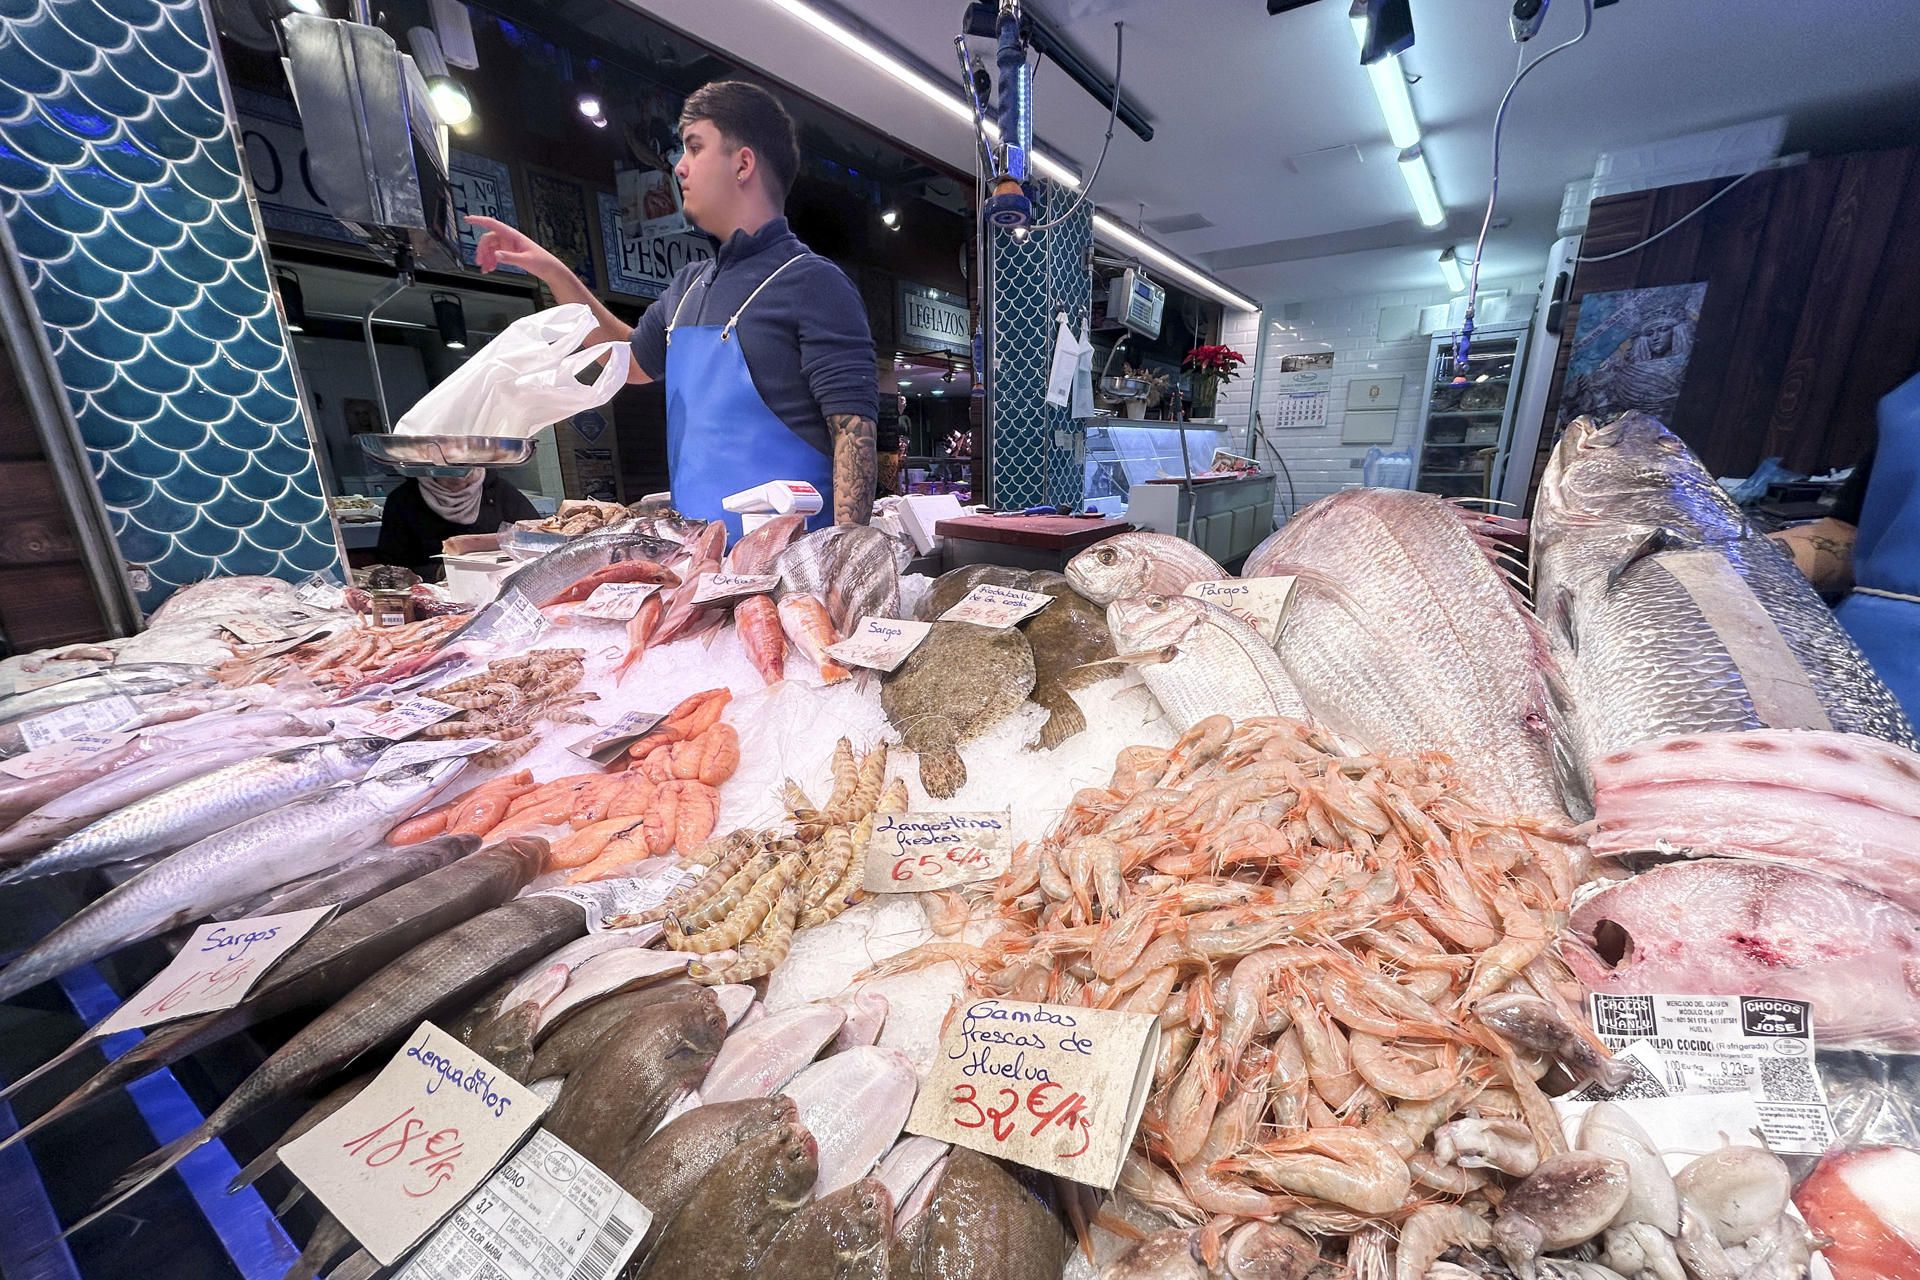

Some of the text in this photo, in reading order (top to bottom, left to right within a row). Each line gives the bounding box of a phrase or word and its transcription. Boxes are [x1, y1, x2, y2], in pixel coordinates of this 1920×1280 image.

[979, 586, 1034, 601] Rodaballo
[1196, 583, 1249, 607] Pargos
[868, 622, 902, 642] Sargos
[877, 816, 1002, 838] Langostinos
[891, 831, 961, 856] frescos
[201, 927, 281, 961] Sargos
[967, 1000, 1076, 1027] Gambas
[1601, 1001, 1648, 1011] CHOCOS
[1746, 1001, 1801, 1015] CHOCOS
[949, 1016, 1093, 1059] frescas de
[1751, 1023, 1797, 1032] JOSE
[1677, 1038, 1713, 1052] COCIDO
[1716, 1042, 1769, 1052] (Refrigerado)
[962, 1046, 1052, 1083] Huelva
[476, 1197, 494, 1215] 3,7
[467, 1227, 485, 1242] FLOR
[483, 1241, 503, 1262] MARIA
